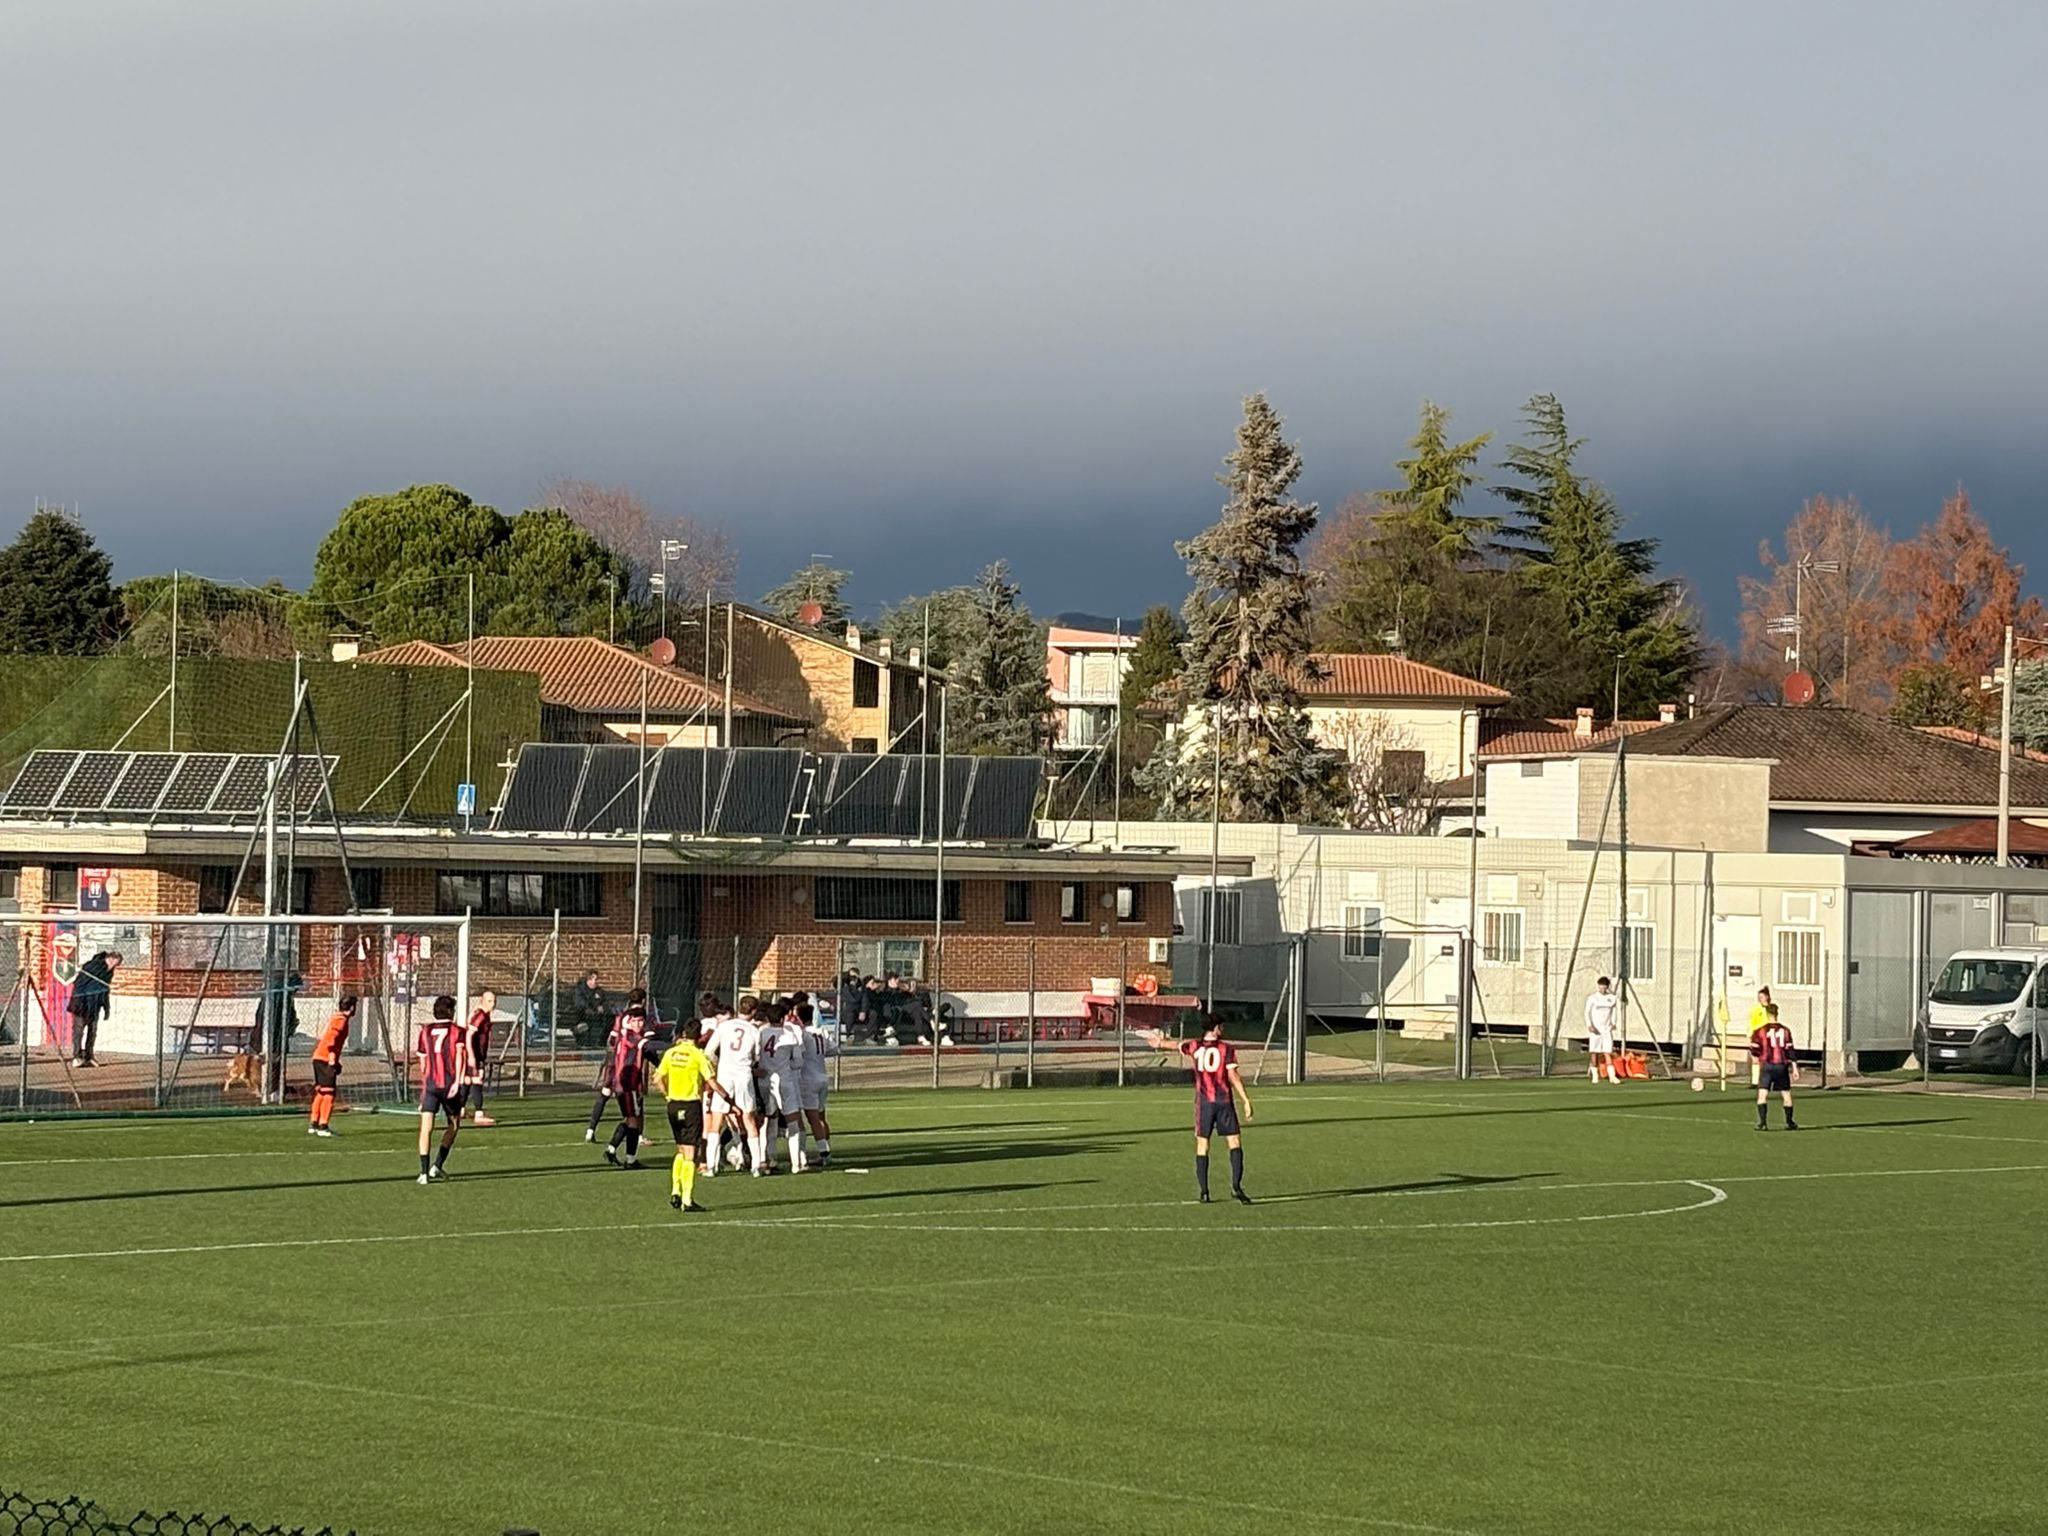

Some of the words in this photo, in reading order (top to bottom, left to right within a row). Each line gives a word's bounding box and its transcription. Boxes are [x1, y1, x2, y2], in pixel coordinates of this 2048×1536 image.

[430, 1028, 449, 1053] 7
[730, 1028, 745, 1051] 3
[764, 1034, 776, 1058] 4
[1766, 1027, 1785, 1048] 11
[1193, 1046, 1220, 1072] 10
